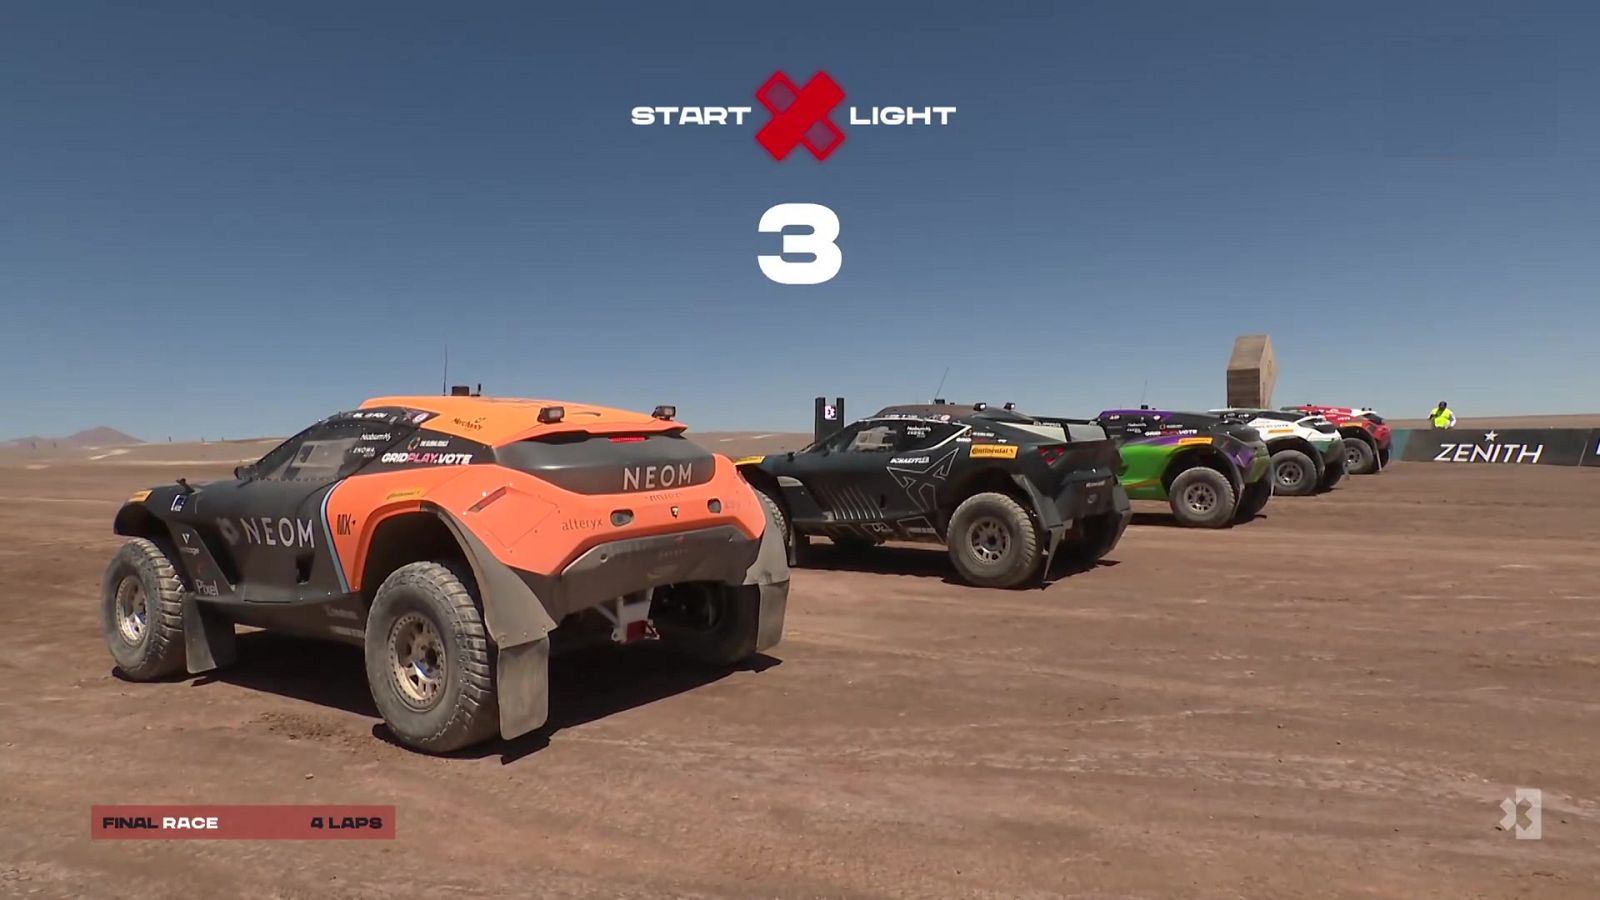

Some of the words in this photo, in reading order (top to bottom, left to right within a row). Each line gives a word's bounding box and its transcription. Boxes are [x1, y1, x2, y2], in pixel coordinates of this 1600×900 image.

[381, 452, 473, 464] GRIDPLAY.VOTE
[1434, 443, 1543, 463] ZENITH
[623, 463, 693, 490] NEOM
[239, 517, 314, 548] NEOM
[562, 517, 603, 532] alteryx
